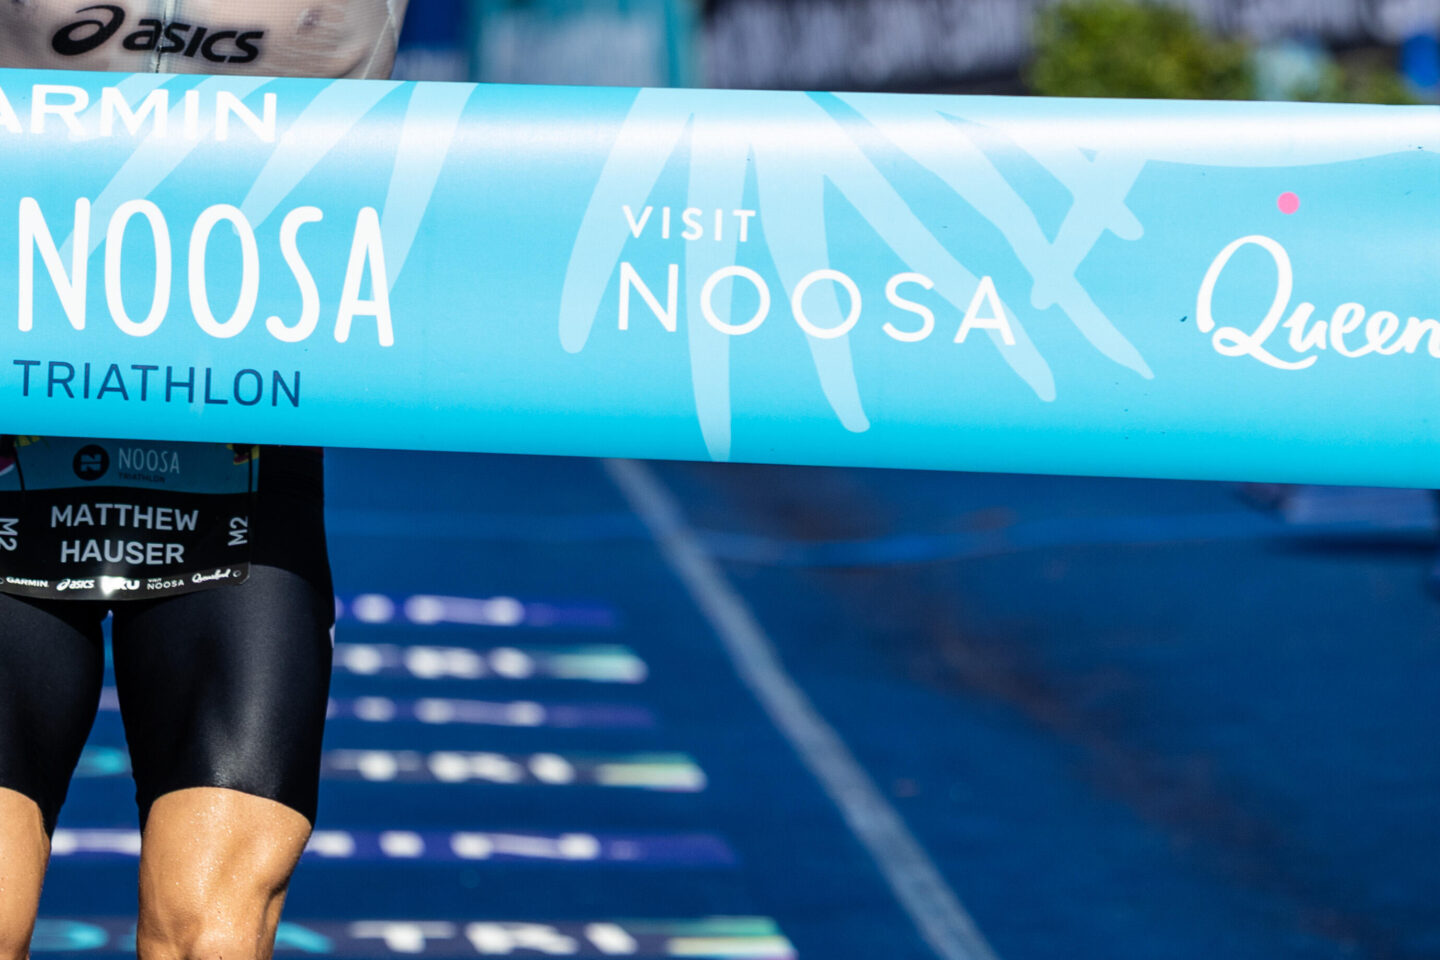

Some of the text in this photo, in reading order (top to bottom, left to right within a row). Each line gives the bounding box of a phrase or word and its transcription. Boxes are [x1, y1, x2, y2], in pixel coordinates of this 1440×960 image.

[622, 205, 756, 243] VISIT
[17, 196, 395, 347] NOOSA
[618, 262, 1016, 346] NOOSA
[13, 359, 301, 408] TRIATHLON
[118, 447, 180, 474] NOOSA
[50, 503, 199, 531] MATTHEW
[227, 516, 248, 546] M2
[60, 539, 184, 565] HAUSER
[6, 576, 49, 588] GARMIN
[147, 579, 185, 590] NOOSA
